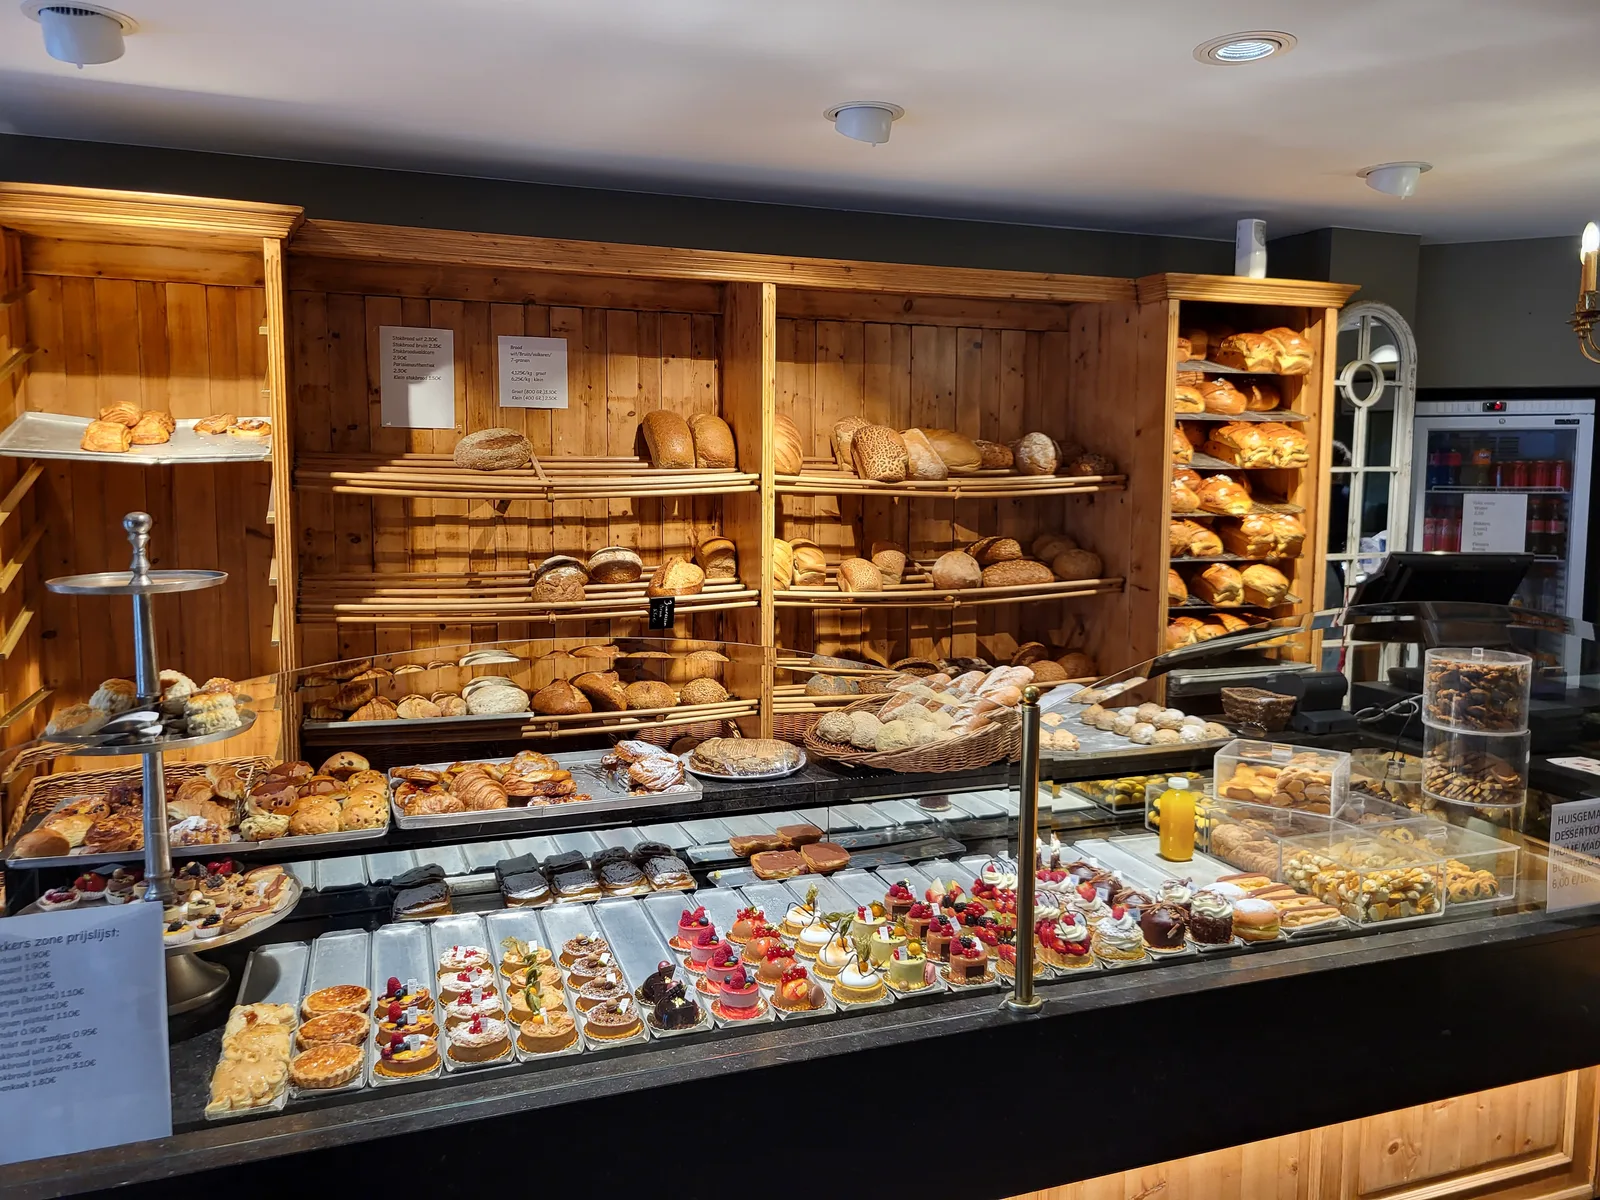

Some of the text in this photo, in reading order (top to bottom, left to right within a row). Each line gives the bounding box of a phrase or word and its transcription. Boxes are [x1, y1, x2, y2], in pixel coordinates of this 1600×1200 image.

[34, 935, 64, 947] zone
[66, 928, 120, 945] prijslijst:
[72, 1027, 98, 1038] 0.95€
[46, 1042, 73, 1053] 2.40€
